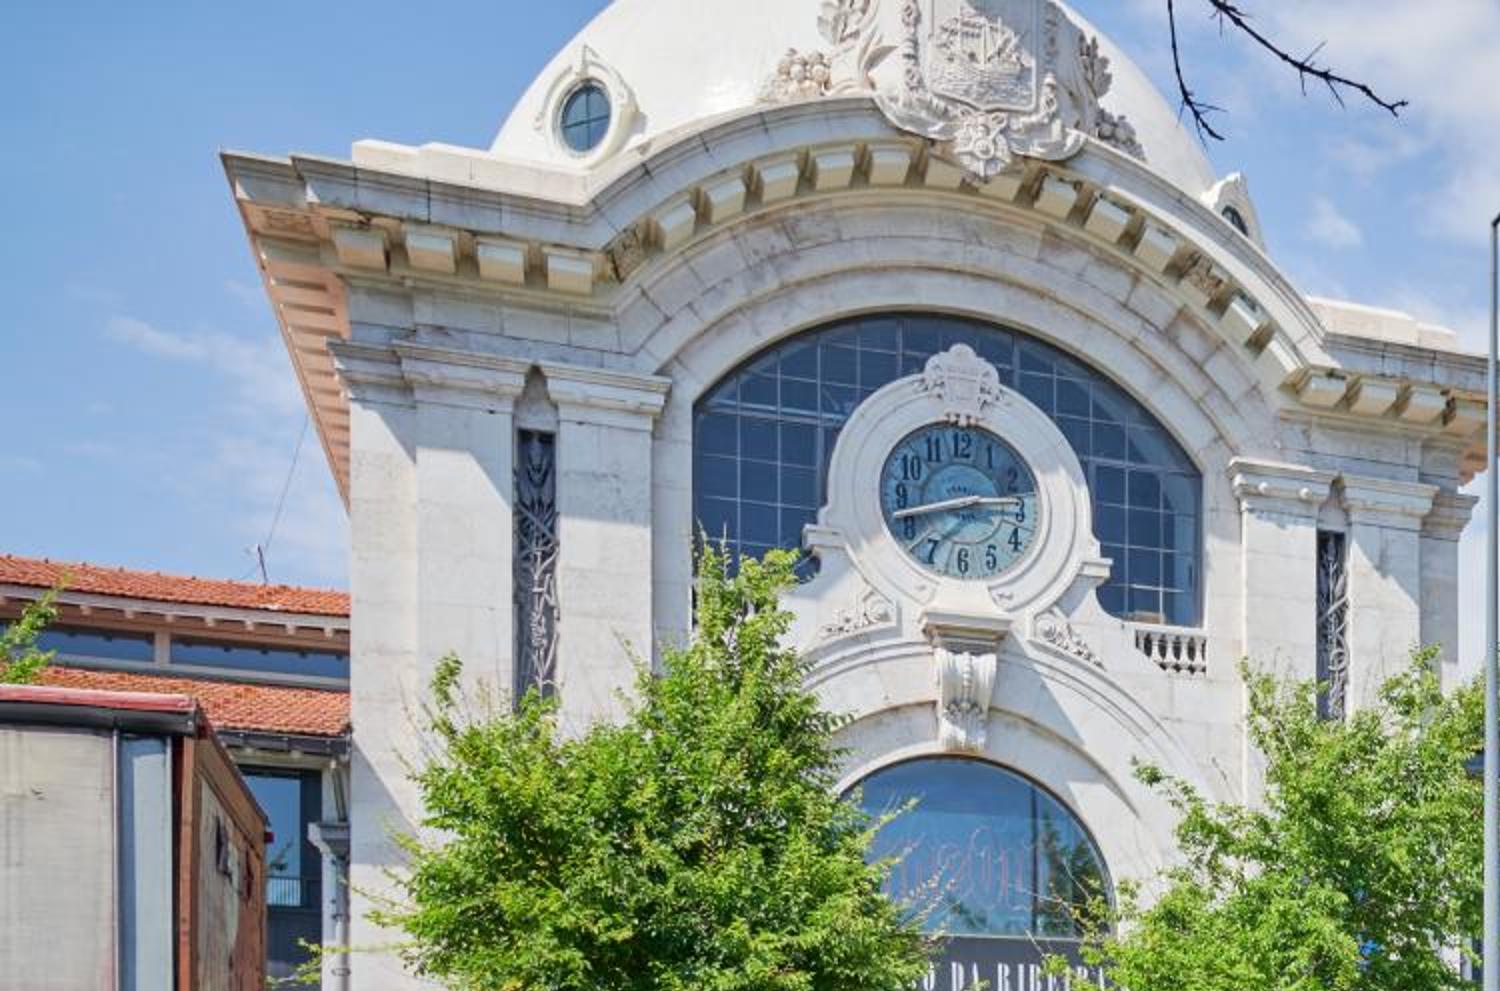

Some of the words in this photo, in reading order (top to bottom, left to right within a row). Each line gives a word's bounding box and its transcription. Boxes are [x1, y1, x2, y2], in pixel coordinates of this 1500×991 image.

[926, 436, 941, 462] 11
[953, 433, 971, 459] 12
[986, 444, 993, 469] 1
[902, 454, 921, 481] 10
[1007, 467, 1018, 491] 2
[895, 483, 908, 509] 9
[1014, 496, 1025, 523] 3
[904, 515, 916, 541] 8
[1008, 527, 1022, 551] 4
[927, 539, 939, 565] 7
[957, 548, 969, 574] 6
[985, 544, 997, 570] 5
